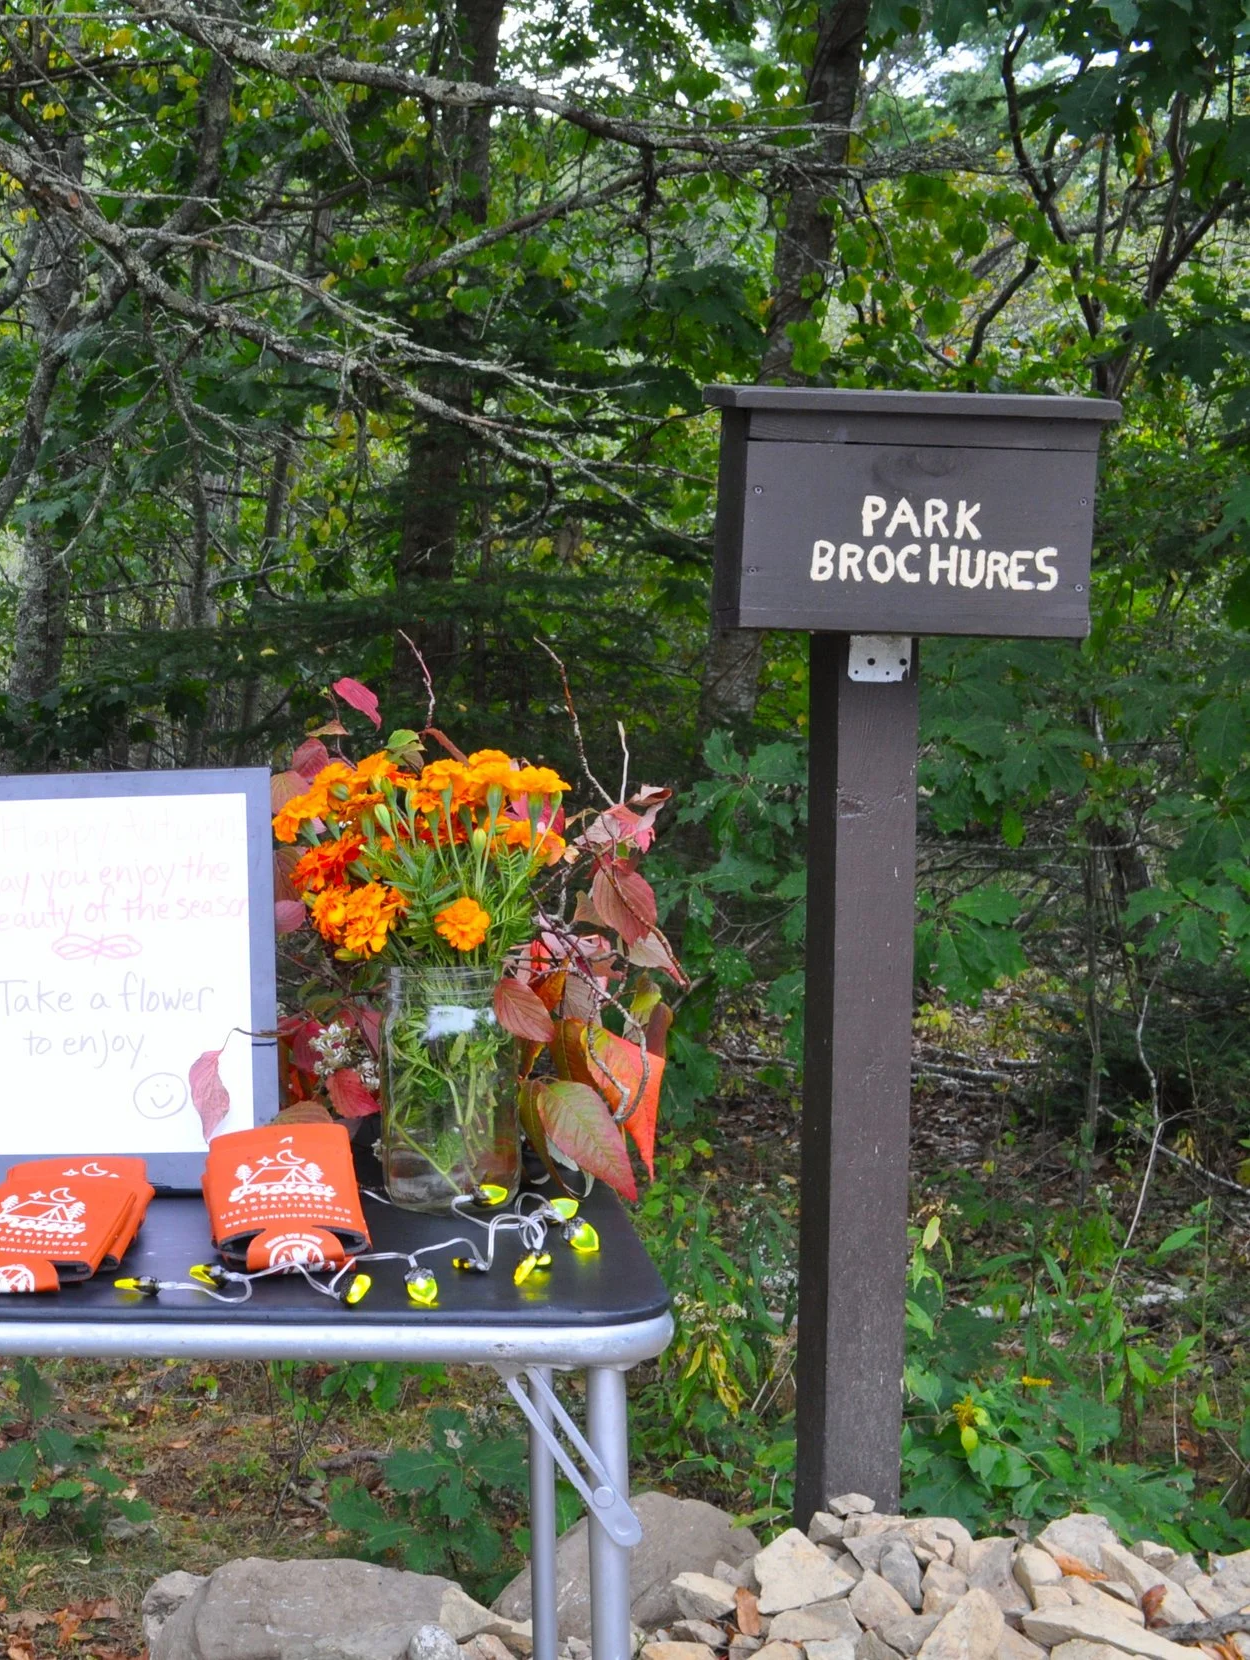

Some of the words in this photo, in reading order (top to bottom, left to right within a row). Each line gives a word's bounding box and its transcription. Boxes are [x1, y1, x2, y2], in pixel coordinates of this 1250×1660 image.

[861, 495, 983, 540] PARK
[809, 539, 1059, 591] BROCHURES
[41, 866, 91, 910] you
[99, 860, 176, 902] enjoy
[182, 852, 231, 886] the
[84, 888, 116, 923] of
[122, 898, 169, 923] the
[90, 992, 111, 1010] a
[118, 970, 215, 1014] flower
[24, 1030, 53, 1056] to
[244, 1203, 283, 1213] LOCAL
